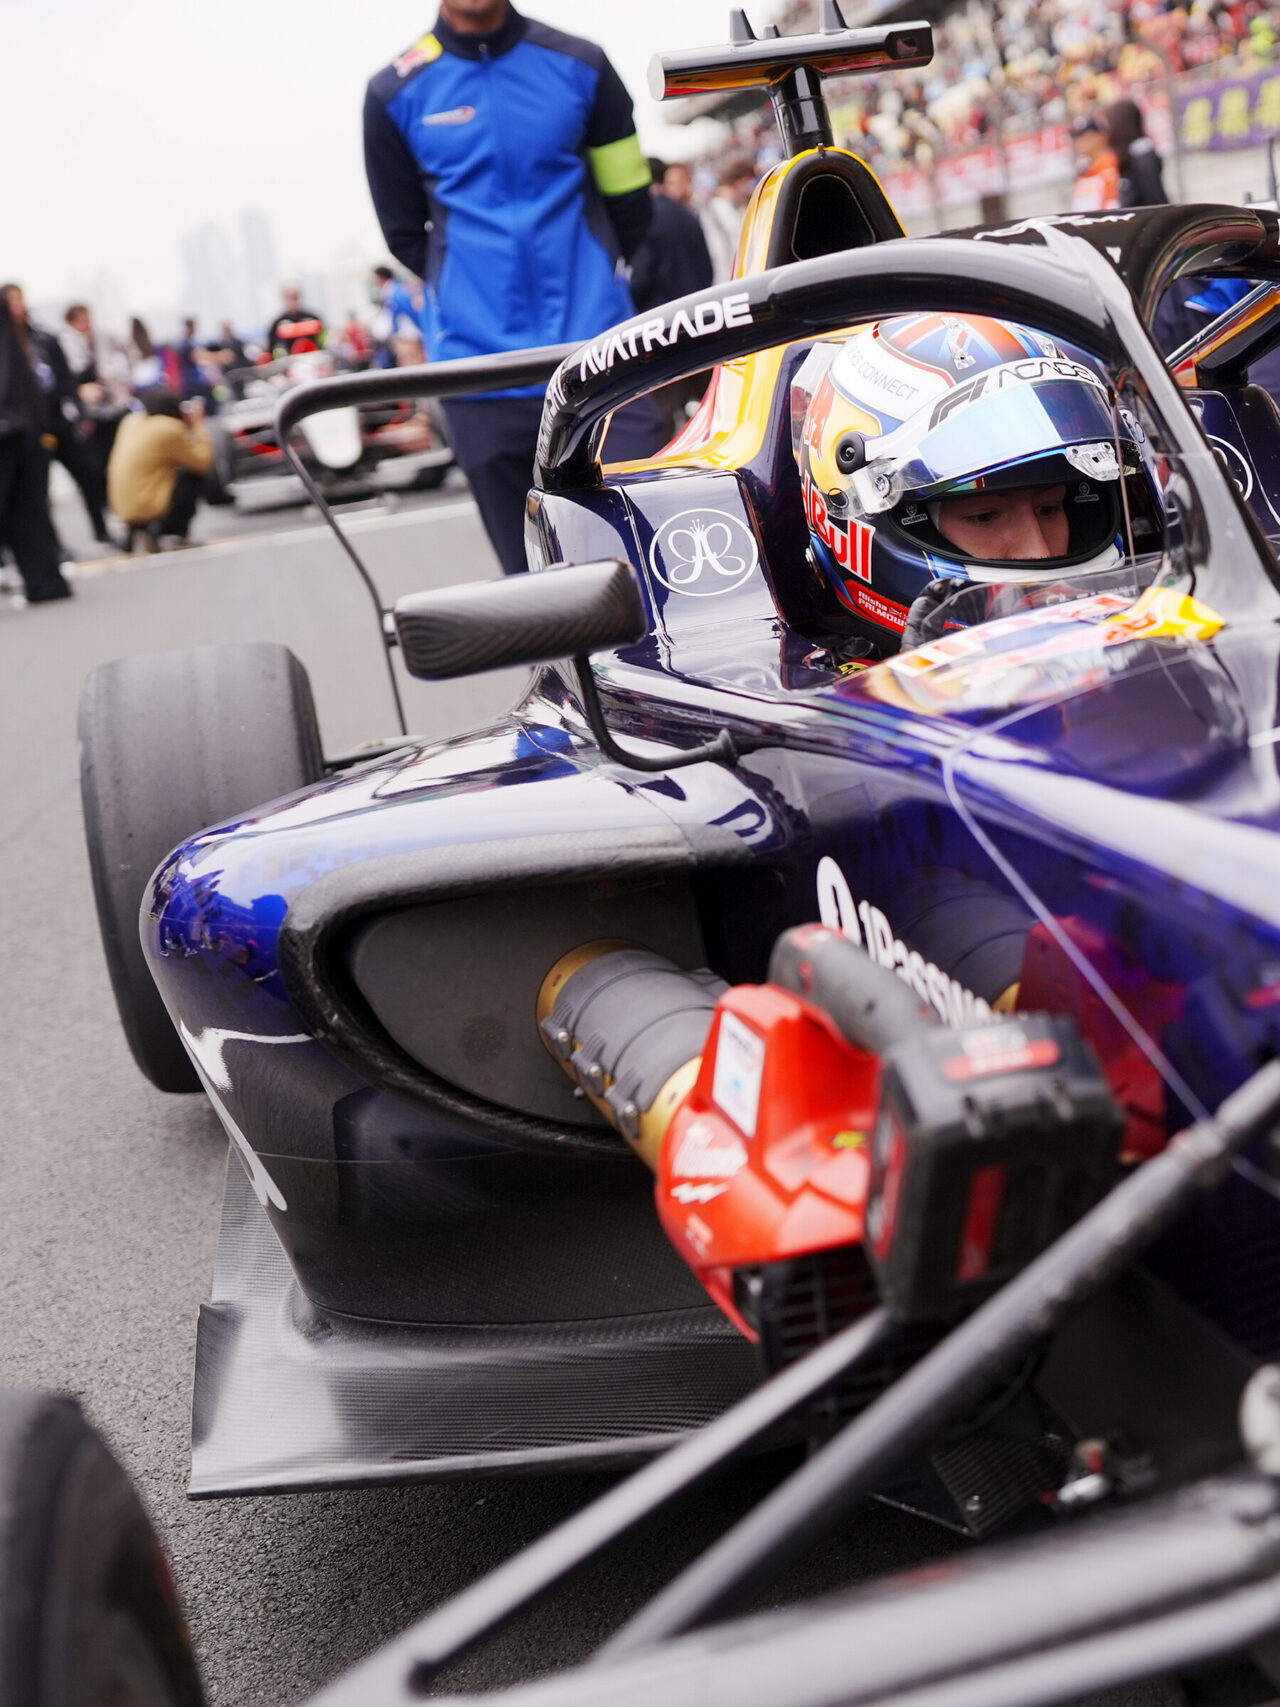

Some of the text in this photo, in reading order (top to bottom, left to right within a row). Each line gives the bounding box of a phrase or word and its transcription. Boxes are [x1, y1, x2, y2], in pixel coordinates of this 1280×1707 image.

[580, 292, 753, 382] AVATRADE
[858, 360, 919, 401] CONNECT
[812, 485, 873, 583] Bull
[858, 591, 888, 611] Alisha
